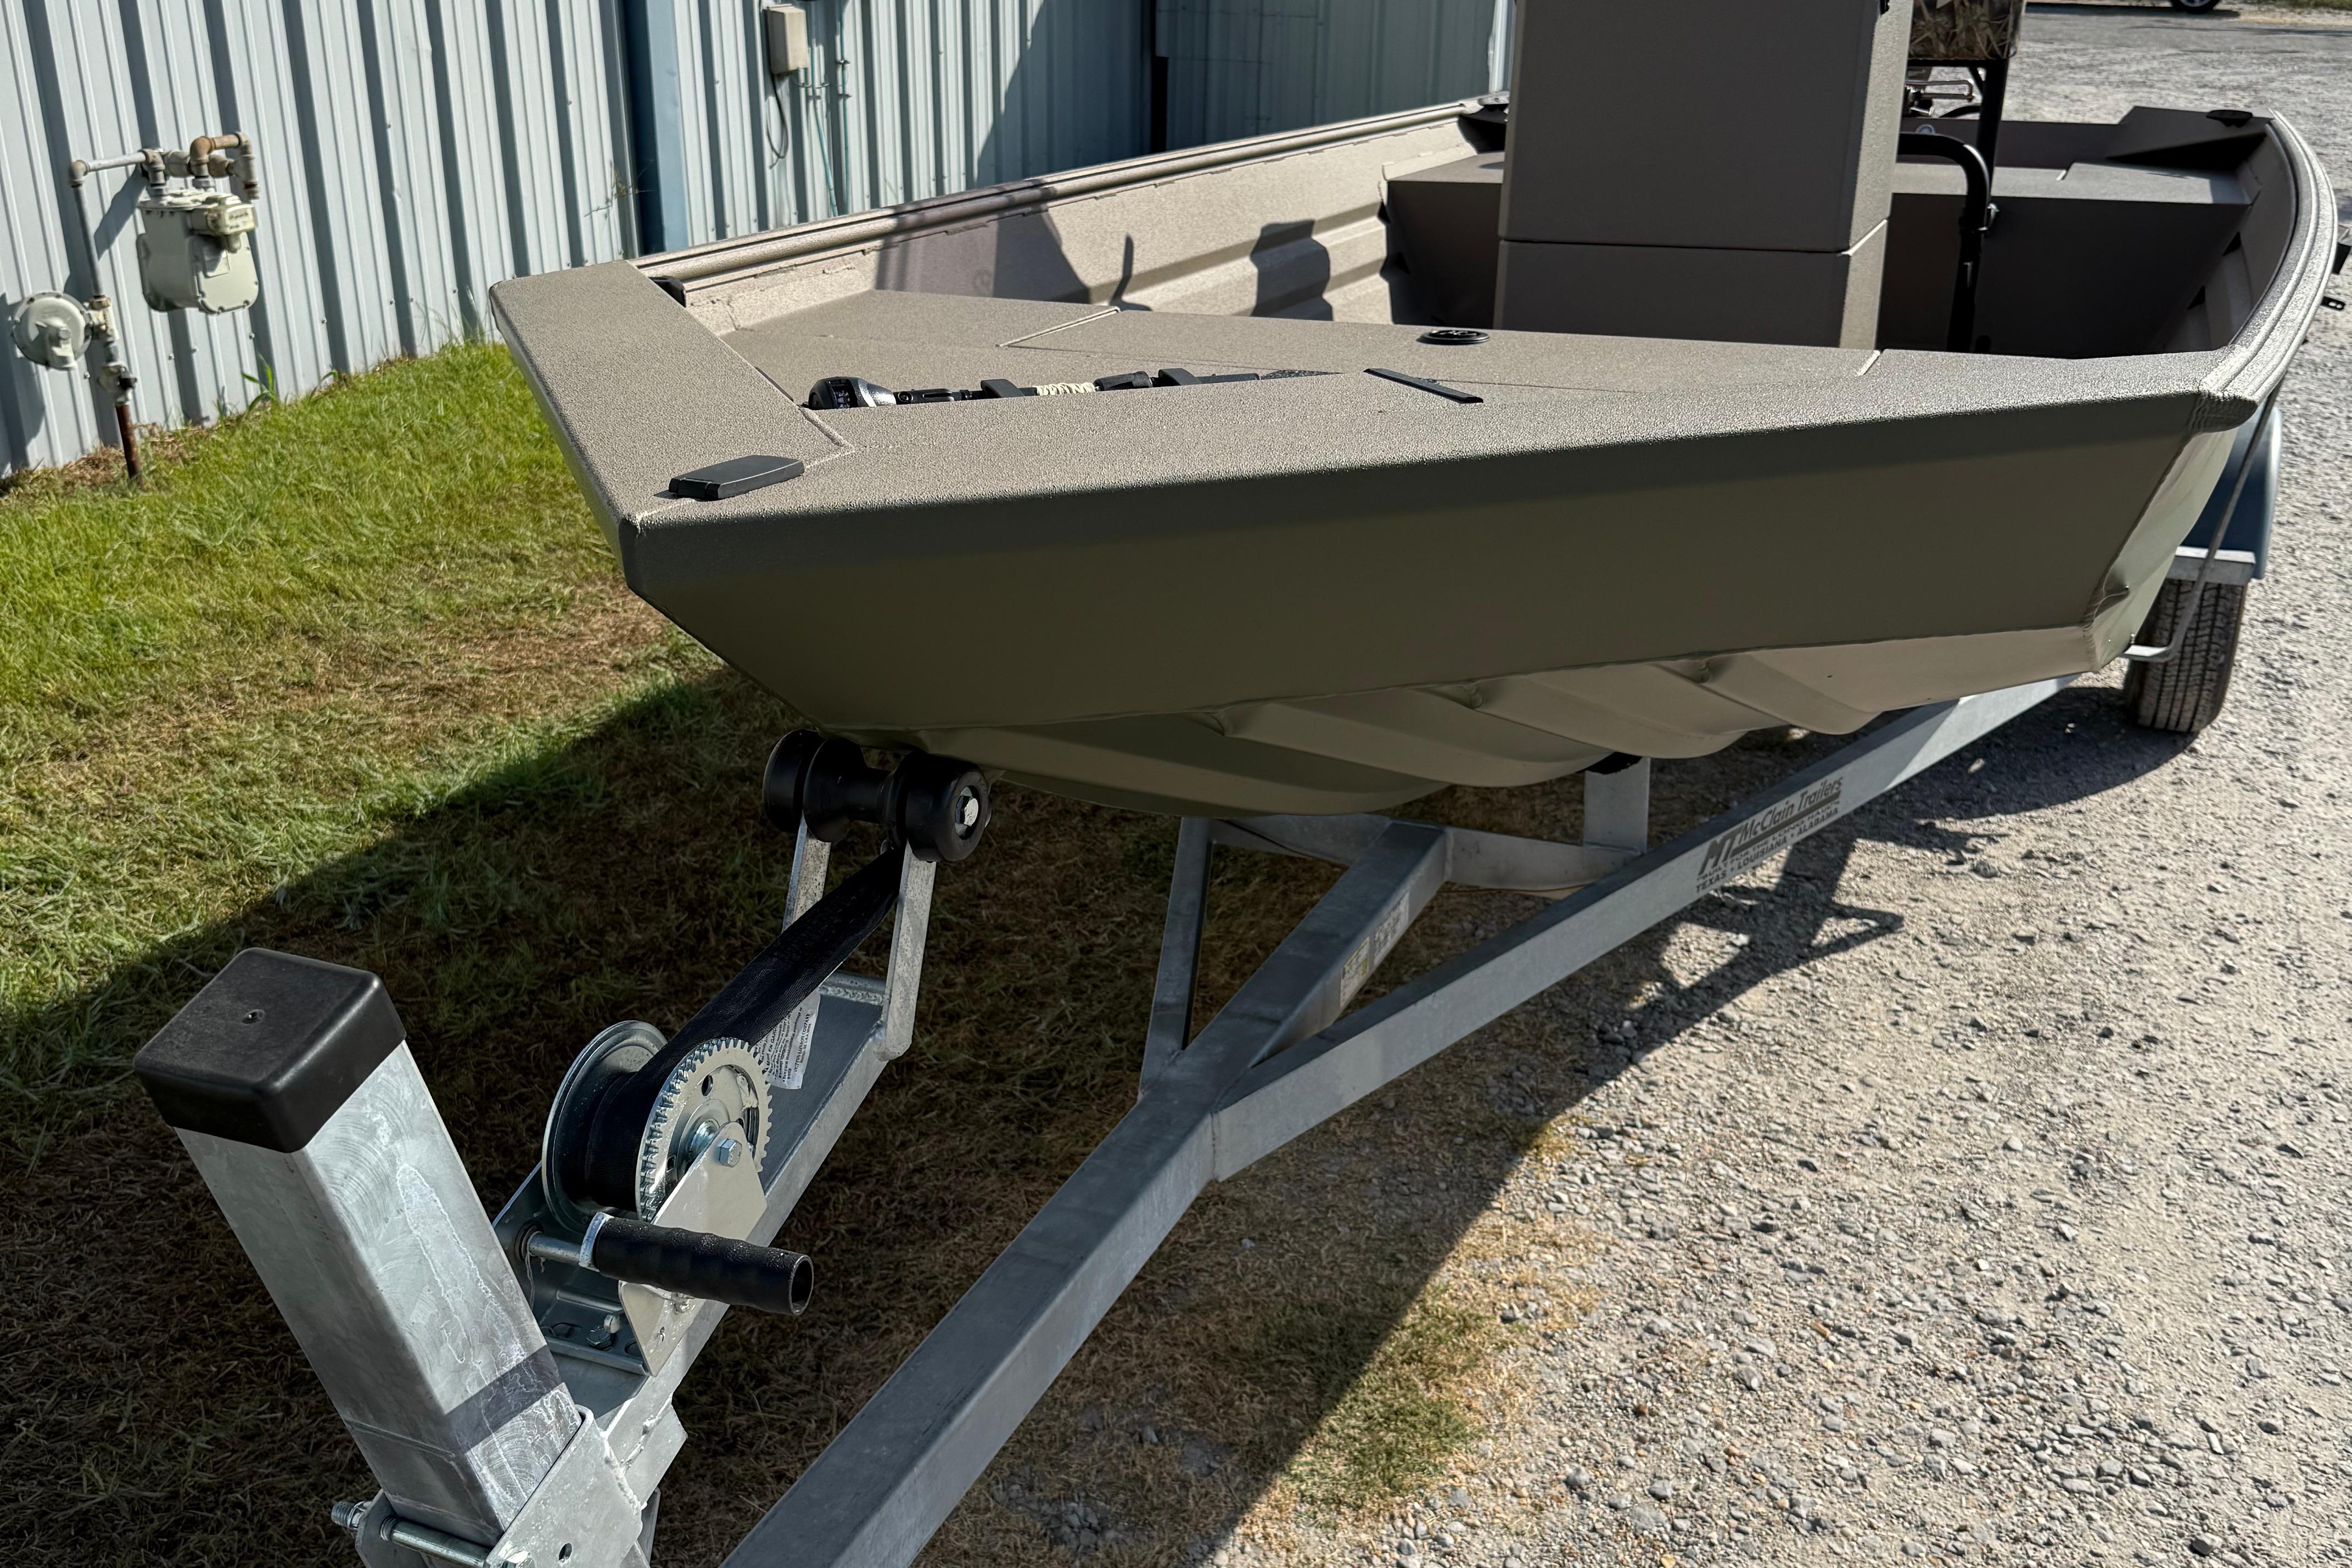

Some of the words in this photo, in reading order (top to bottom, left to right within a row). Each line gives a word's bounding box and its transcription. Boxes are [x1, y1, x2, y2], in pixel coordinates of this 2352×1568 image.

[1738, 800, 1794, 845] McClain
[1799, 776, 1844, 811] Trailers
[1696, 869, 1727, 892] TEXAS
[1738, 836, 1787, 869] LOUISIANA
[1797, 808, 1838, 836] ALABAMA
